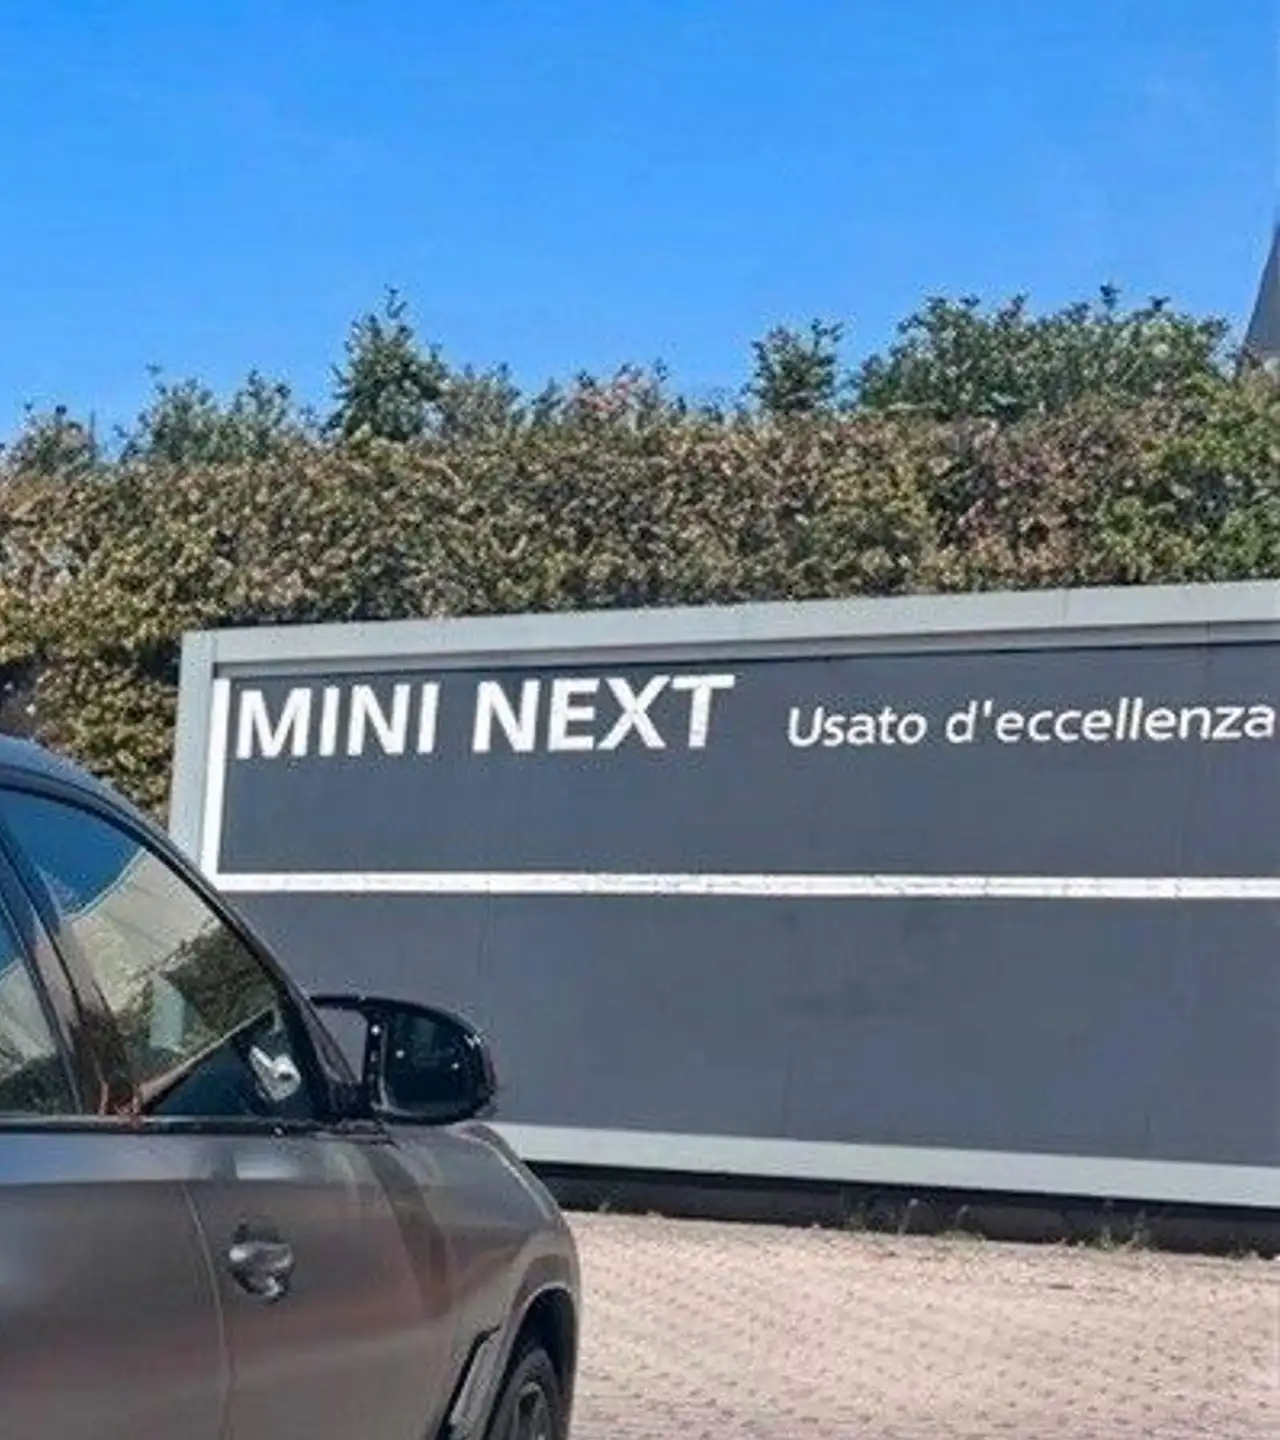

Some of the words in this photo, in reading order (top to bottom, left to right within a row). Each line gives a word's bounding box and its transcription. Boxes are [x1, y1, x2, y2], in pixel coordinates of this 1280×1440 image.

[236, 681, 440, 759] MINI
[472, 673, 736, 753] NEXT
[787, 705, 928, 747] Usato
[945, 697, 1277, 744] d'eccellenza
